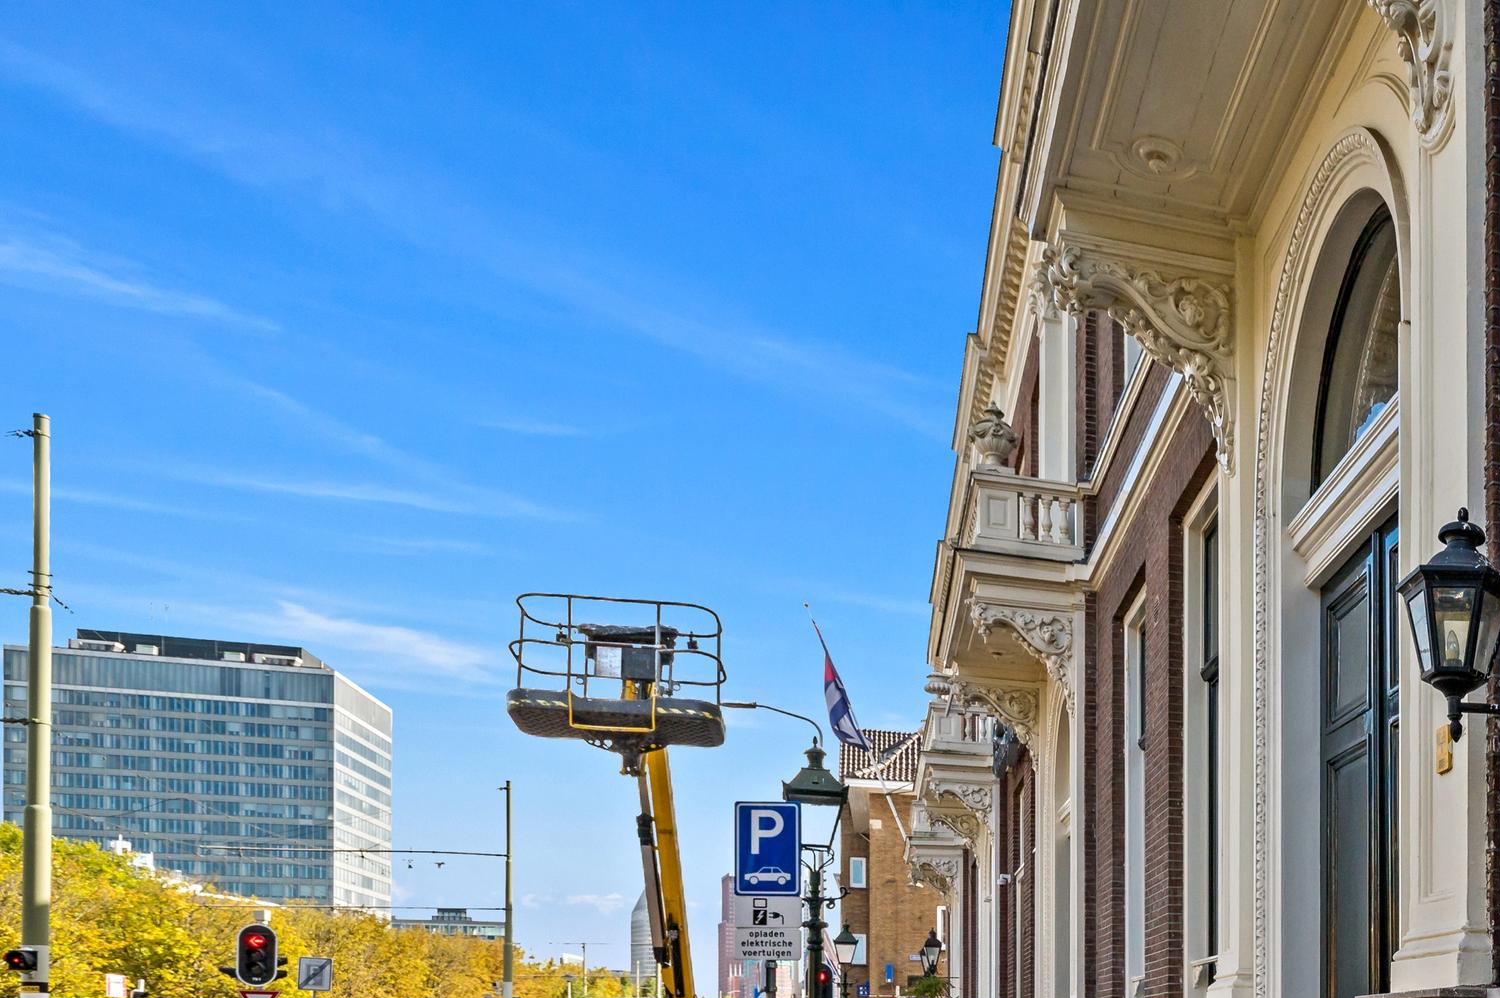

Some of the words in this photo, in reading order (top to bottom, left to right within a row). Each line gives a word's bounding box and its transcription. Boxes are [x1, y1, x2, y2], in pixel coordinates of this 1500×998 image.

[751, 810, 784, 854] P
[749, 930, 785, 938] opladen
[742, 949, 792, 958] voertuigen
